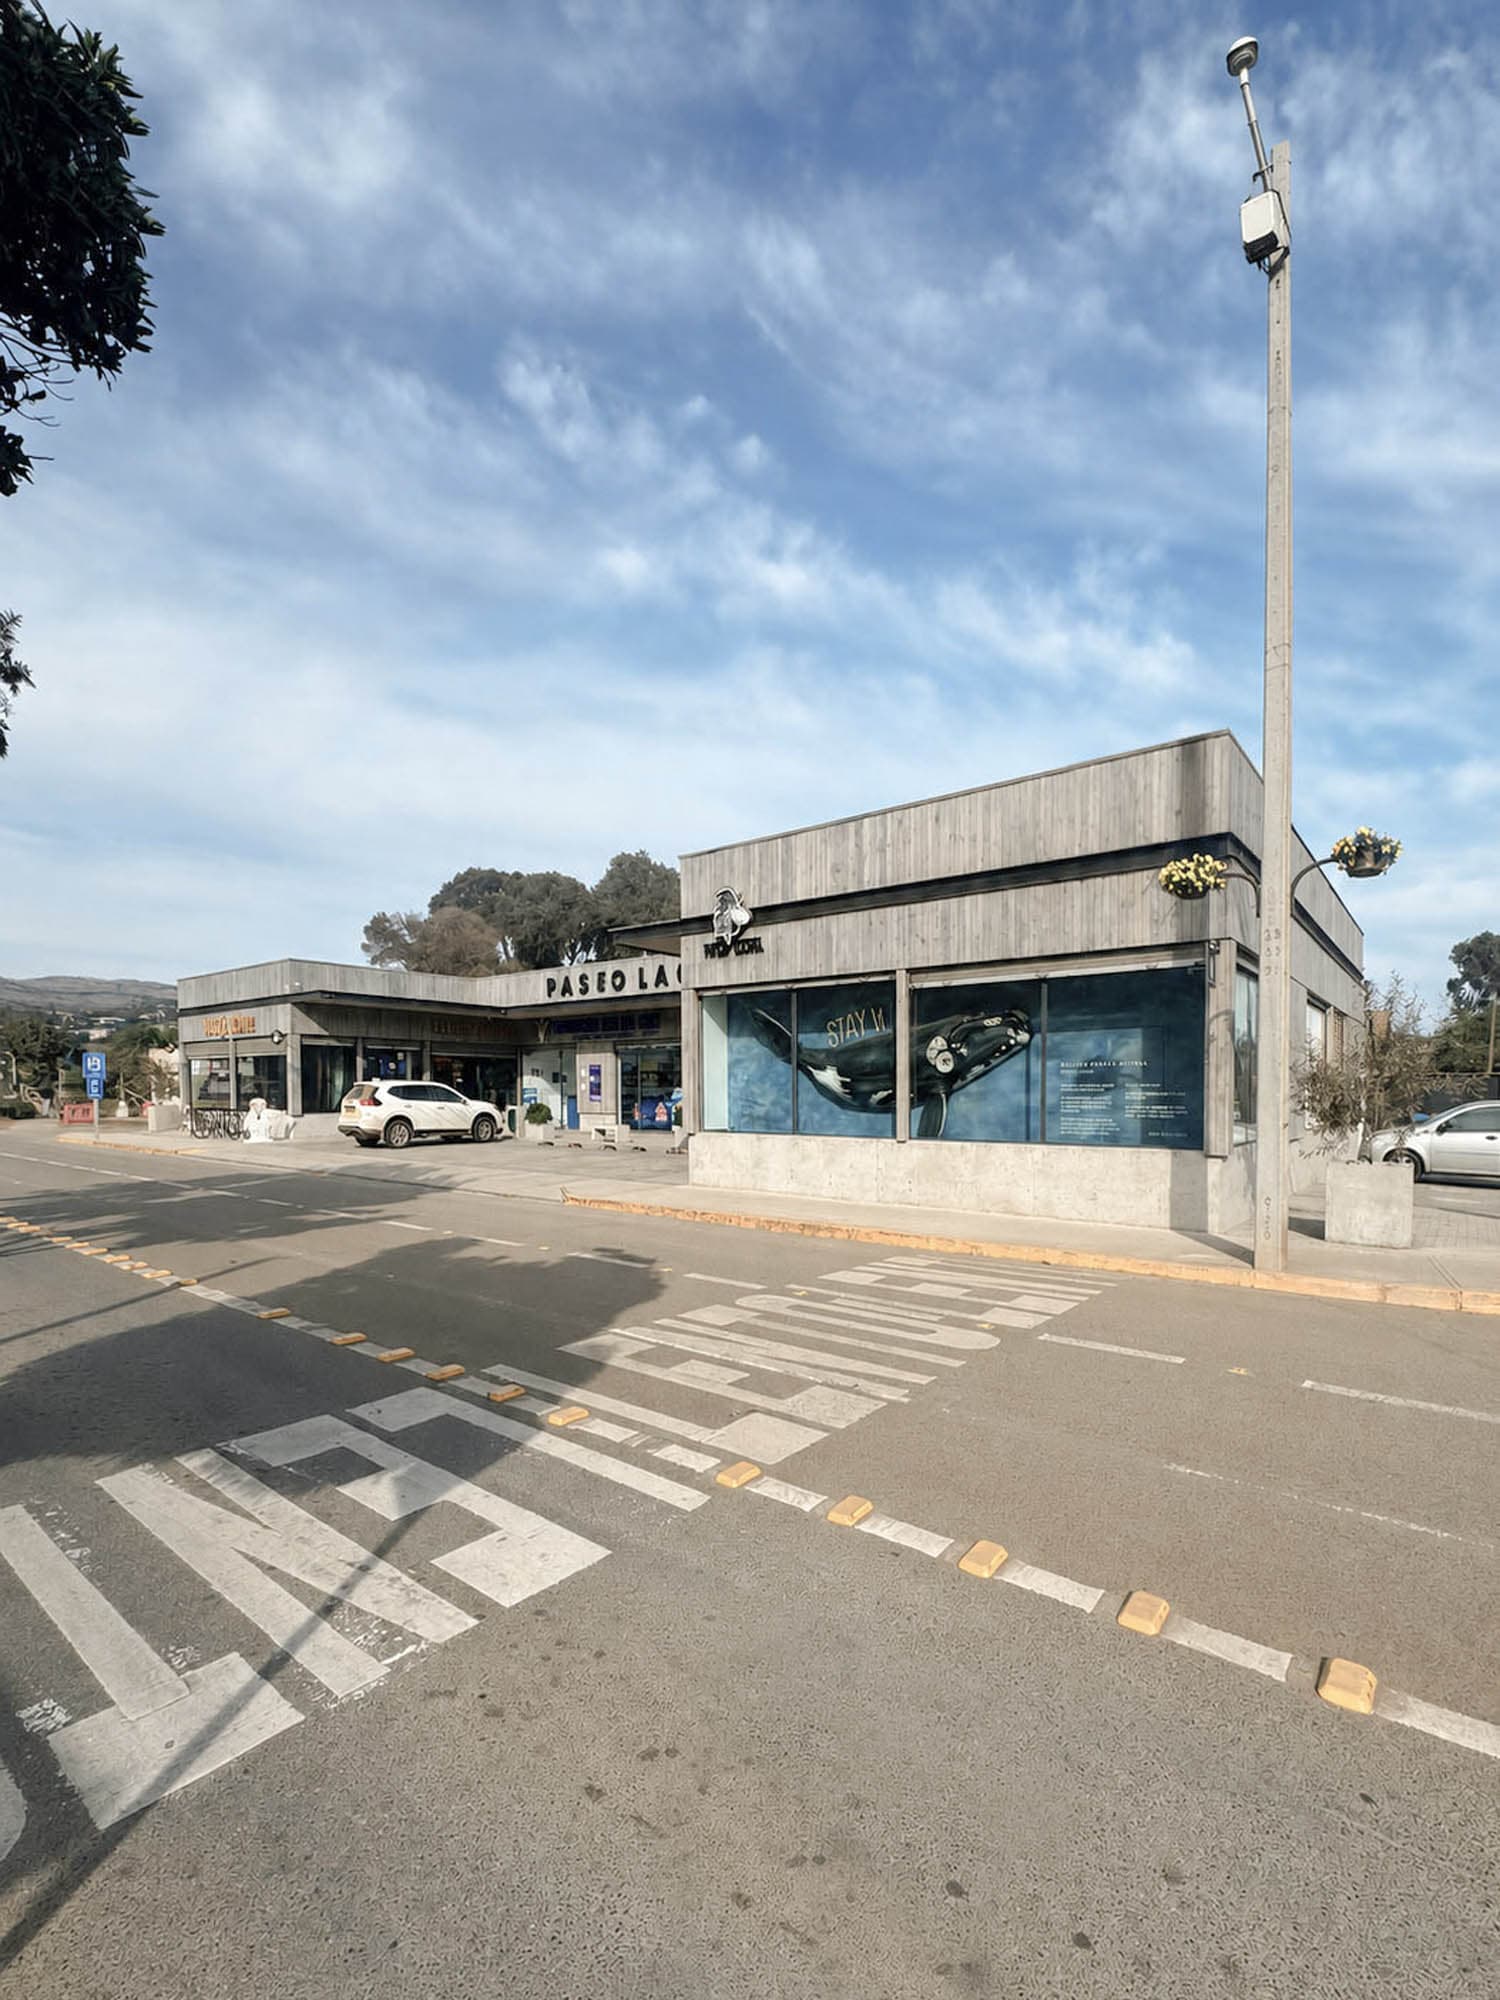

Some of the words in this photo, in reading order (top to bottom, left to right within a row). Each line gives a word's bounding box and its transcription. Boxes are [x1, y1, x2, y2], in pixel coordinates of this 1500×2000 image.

[546, 969, 626, 998] PASEO
[826, 1008, 866, 1048] STAY
[481, 1294, 1001, 1465] LENTO
